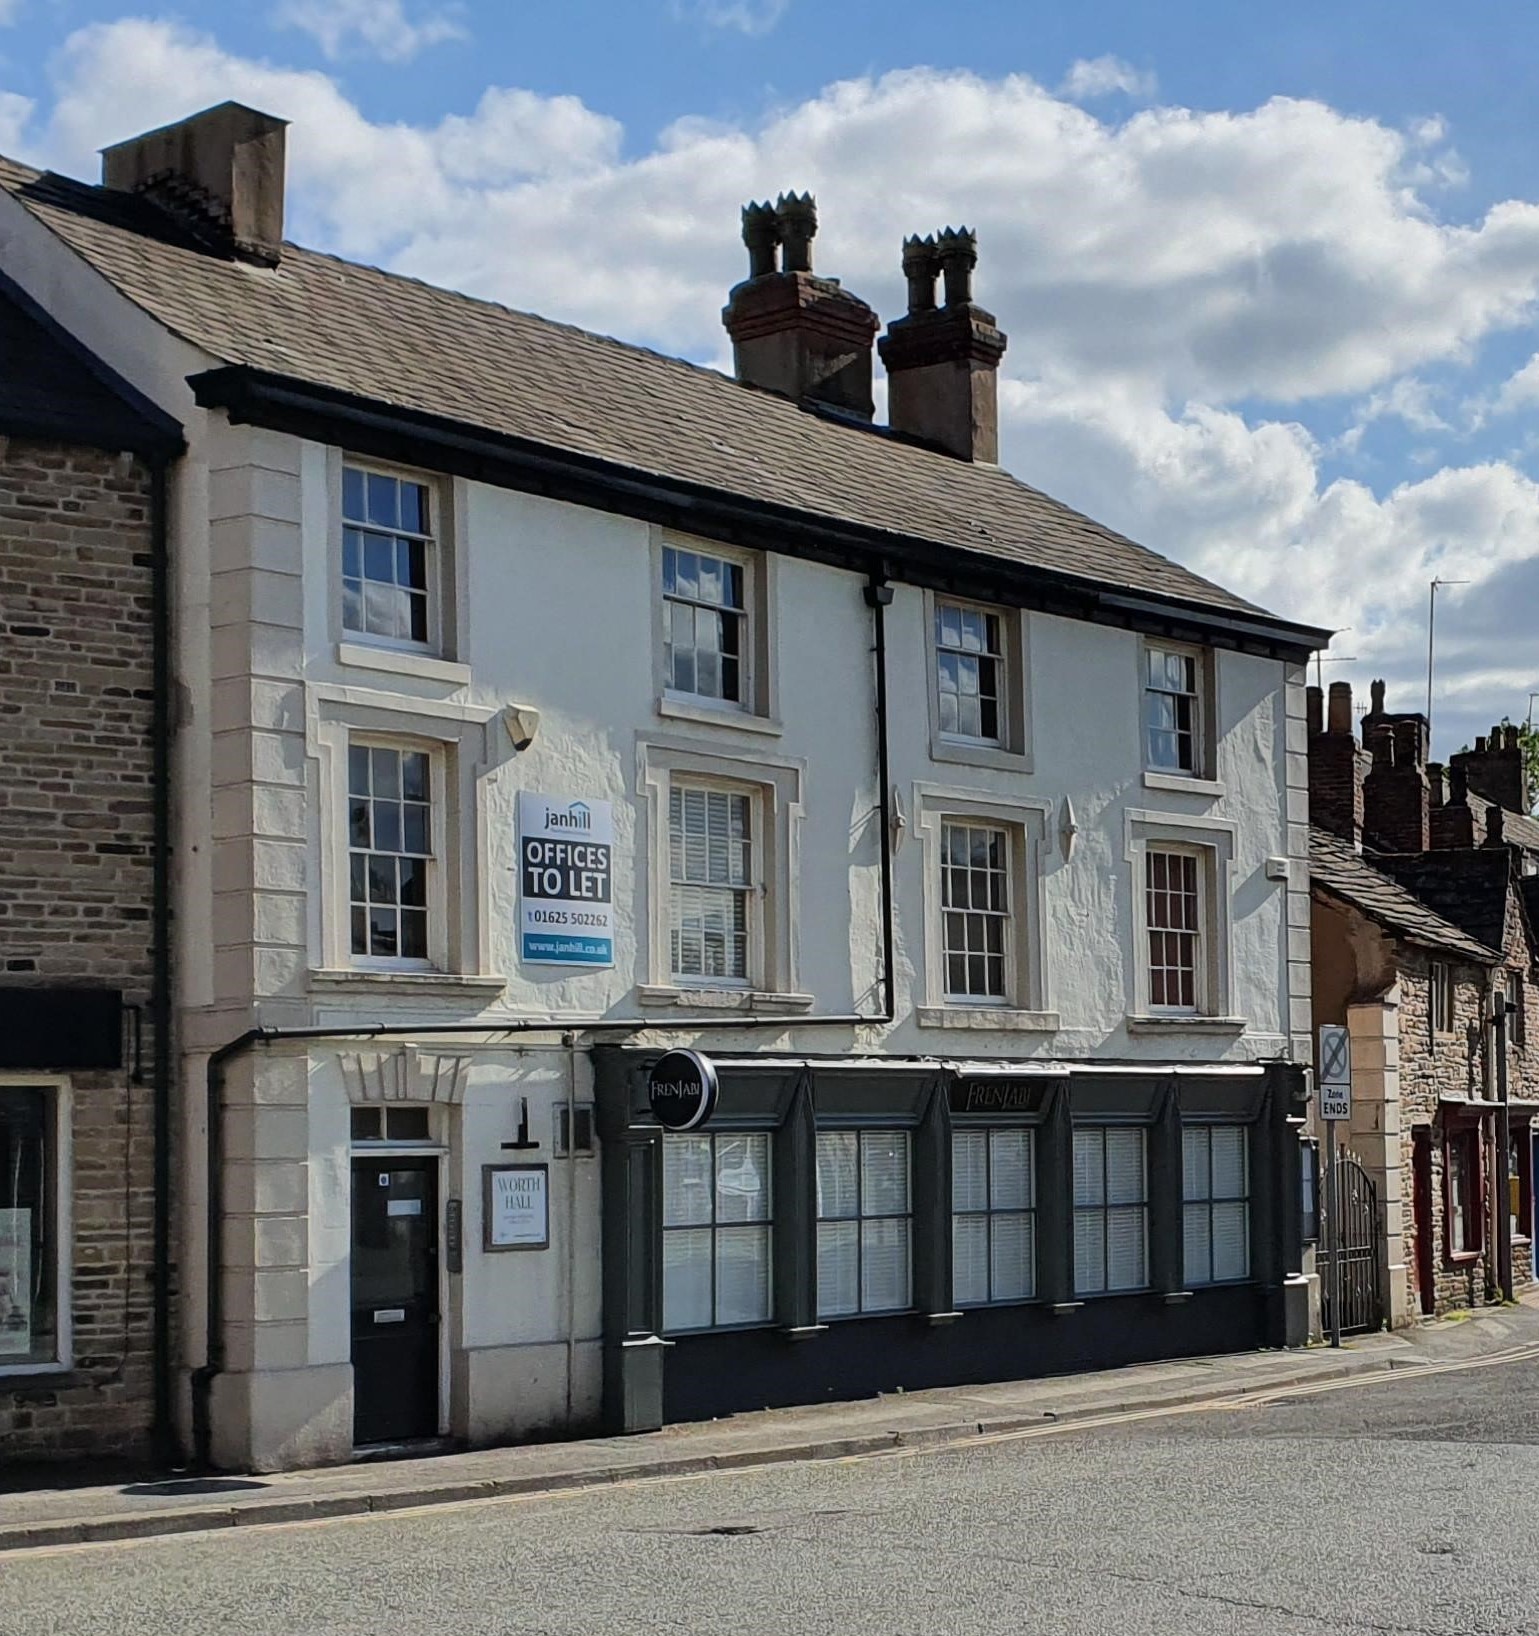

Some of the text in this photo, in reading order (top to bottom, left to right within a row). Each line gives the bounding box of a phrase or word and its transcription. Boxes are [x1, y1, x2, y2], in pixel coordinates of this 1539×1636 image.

[544, 807, 591, 829] janhill
[526, 841, 608, 870] OFFICES
[528, 867, 607, 898] TO LET
[534, 910, 568, 925] 01625
[571, 912, 608, 927] 502262
[528, 941, 608, 956] www.janhill.co.uk
[1323, 1102, 1349, 1115] ENDS
[497, 1176, 540, 1192] WORTH
[505, 1195, 535, 1209] HALL
